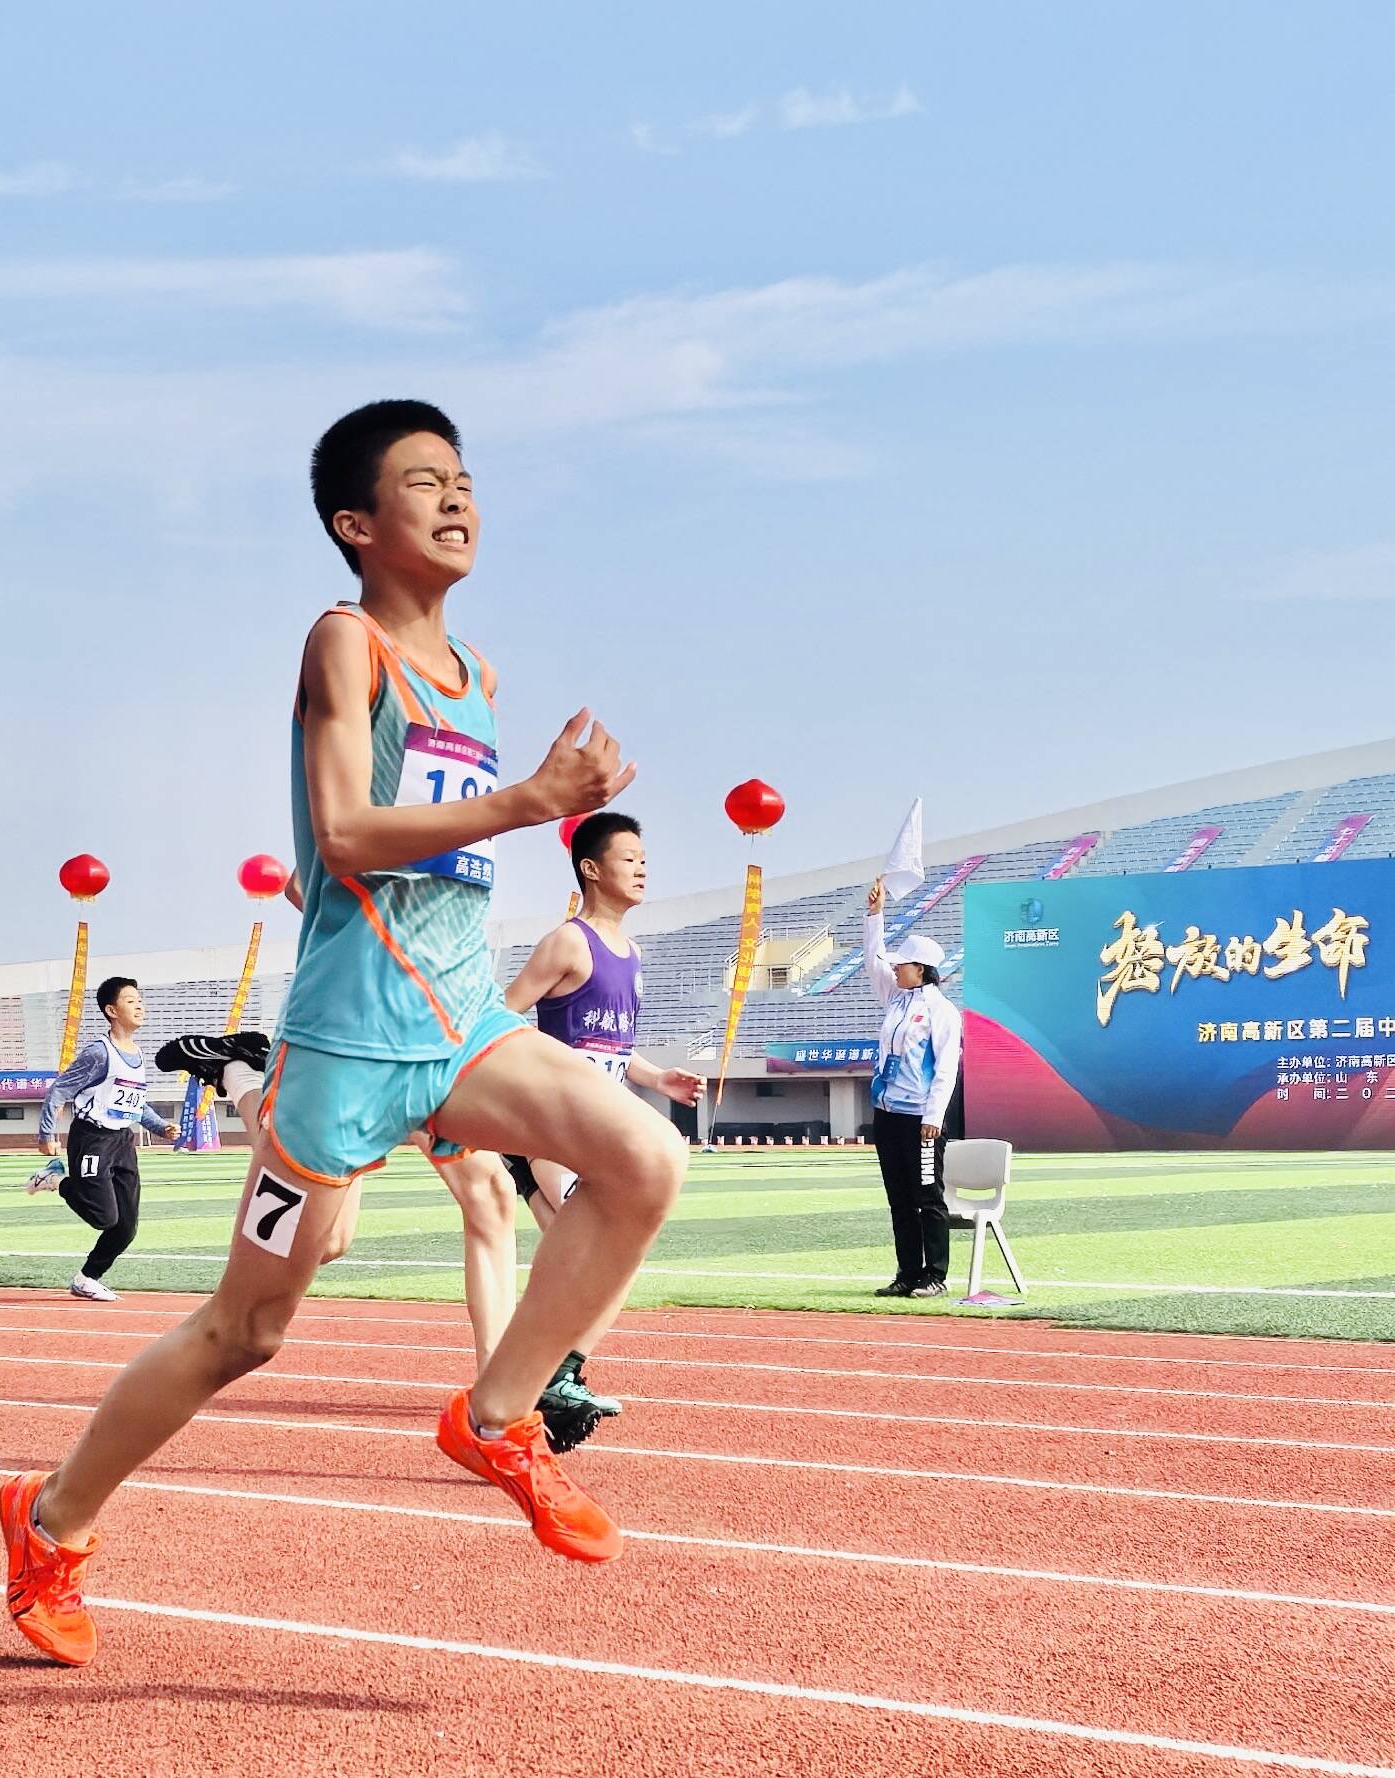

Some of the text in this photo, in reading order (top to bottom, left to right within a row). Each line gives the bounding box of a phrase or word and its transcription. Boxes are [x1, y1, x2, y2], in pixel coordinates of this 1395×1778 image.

[1004, 928, 1060, 943] 济南高新区
[1096, 907, 1370, 1028] 怒放的生命
[1197, 1016, 1395, 1043] 济南高新区第二届中
[83, 1156, 94, 1176] 1
[920, 1138, 936, 1186] CHINA
[255, 1173, 303, 1241] 7
